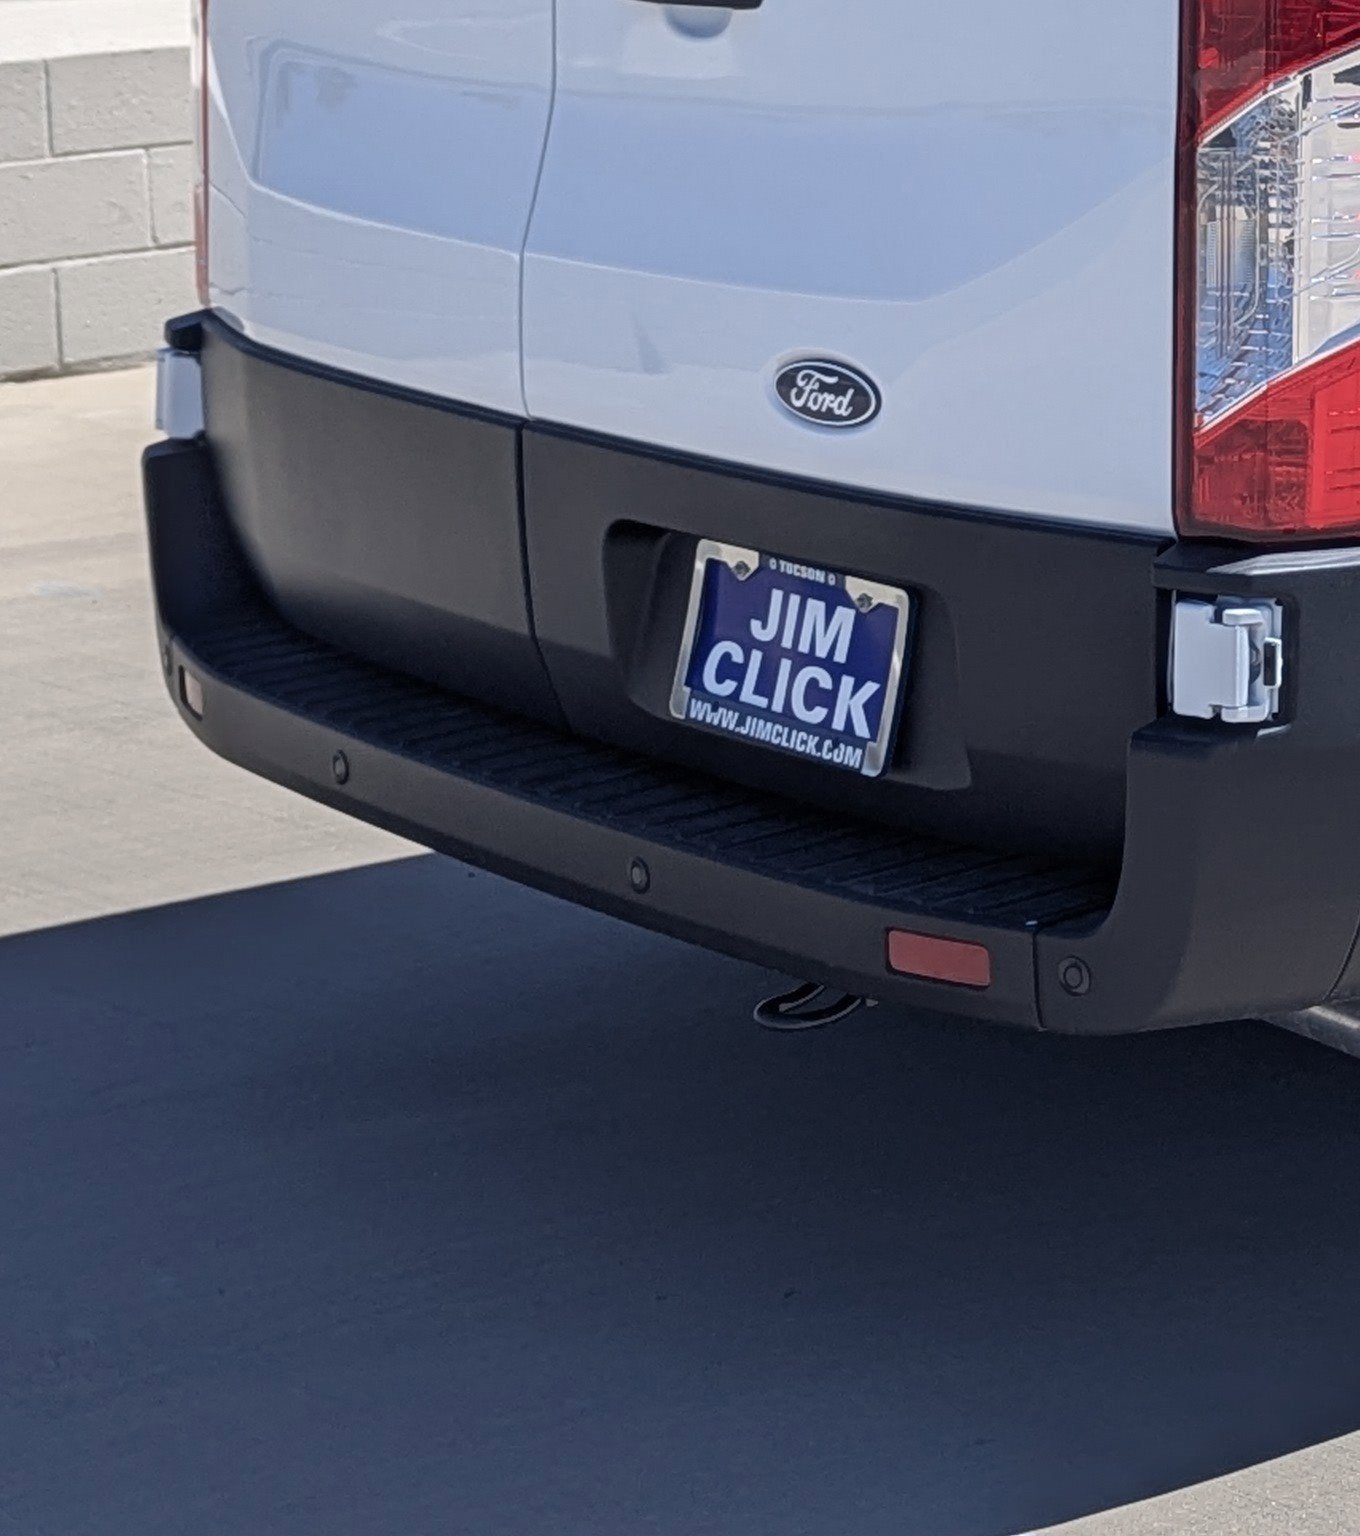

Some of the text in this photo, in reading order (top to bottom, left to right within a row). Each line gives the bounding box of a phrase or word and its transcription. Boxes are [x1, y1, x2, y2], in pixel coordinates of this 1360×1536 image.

[790, 369, 855, 416] Ford
[779, 559, 826, 584] TUCSON
[750, 588, 856, 663] JIM
[703, 640, 881, 739] CLICK
[690, 698, 863, 769] WWW.JIMCLICK.COM
